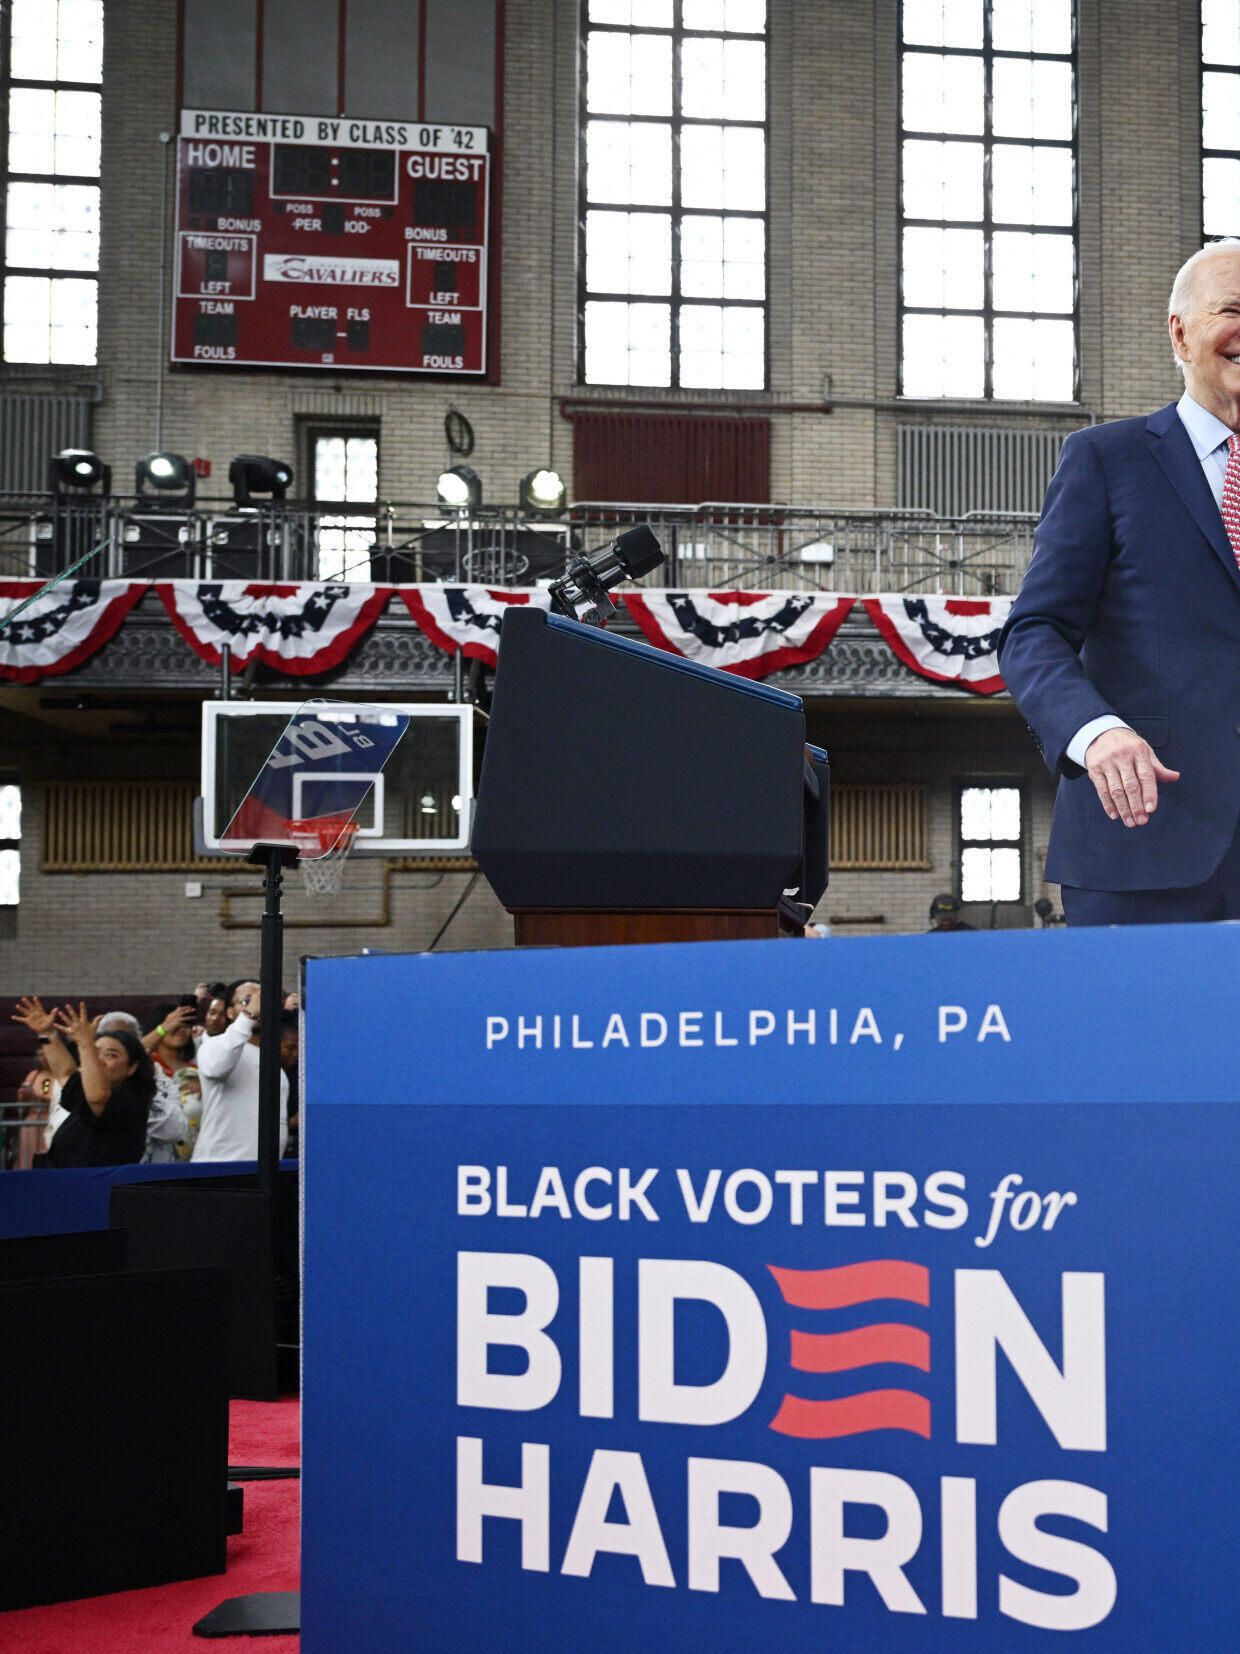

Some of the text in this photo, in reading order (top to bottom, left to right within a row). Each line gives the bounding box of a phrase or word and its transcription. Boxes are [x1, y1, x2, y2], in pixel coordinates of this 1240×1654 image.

[195, 114, 474, 149] PRESENTED BY CLASS OF '42
[188, 143, 256, 169] HOME
[407, 155, 483, 181] GUEST
[286, 203, 314, 214] POSS
[354, 206, 381, 218] POSS
[217, 217, 261, 231] BONUS
[405, 227, 448, 241] BONUS
[186, 236, 248, 251] TIMEOUTS
[416, 248, 476, 262] TIMEOUTS
[280, 257, 397, 284] CAVALIERS
[200, 281, 231, 293] LEFT
[430, 292, 459, 305] LEFT
[199, 301, 234, 314] TEAM
[290, 305, 370, 321] PLAYER FLS
[427, 311, 461, 324] TEAM
[194, 345, 236, 359] FOULS
[423, 355, 463, 368] FOULS
[487, 1005, 1011, 1050] PHILADELPHIA, PA
[457, 1165, 1078, 1248] BLACK VOTERS for
[457, 1251, 1107, 1452] BIDEN
[456, 1436, 1117, 1631] HARRIS
